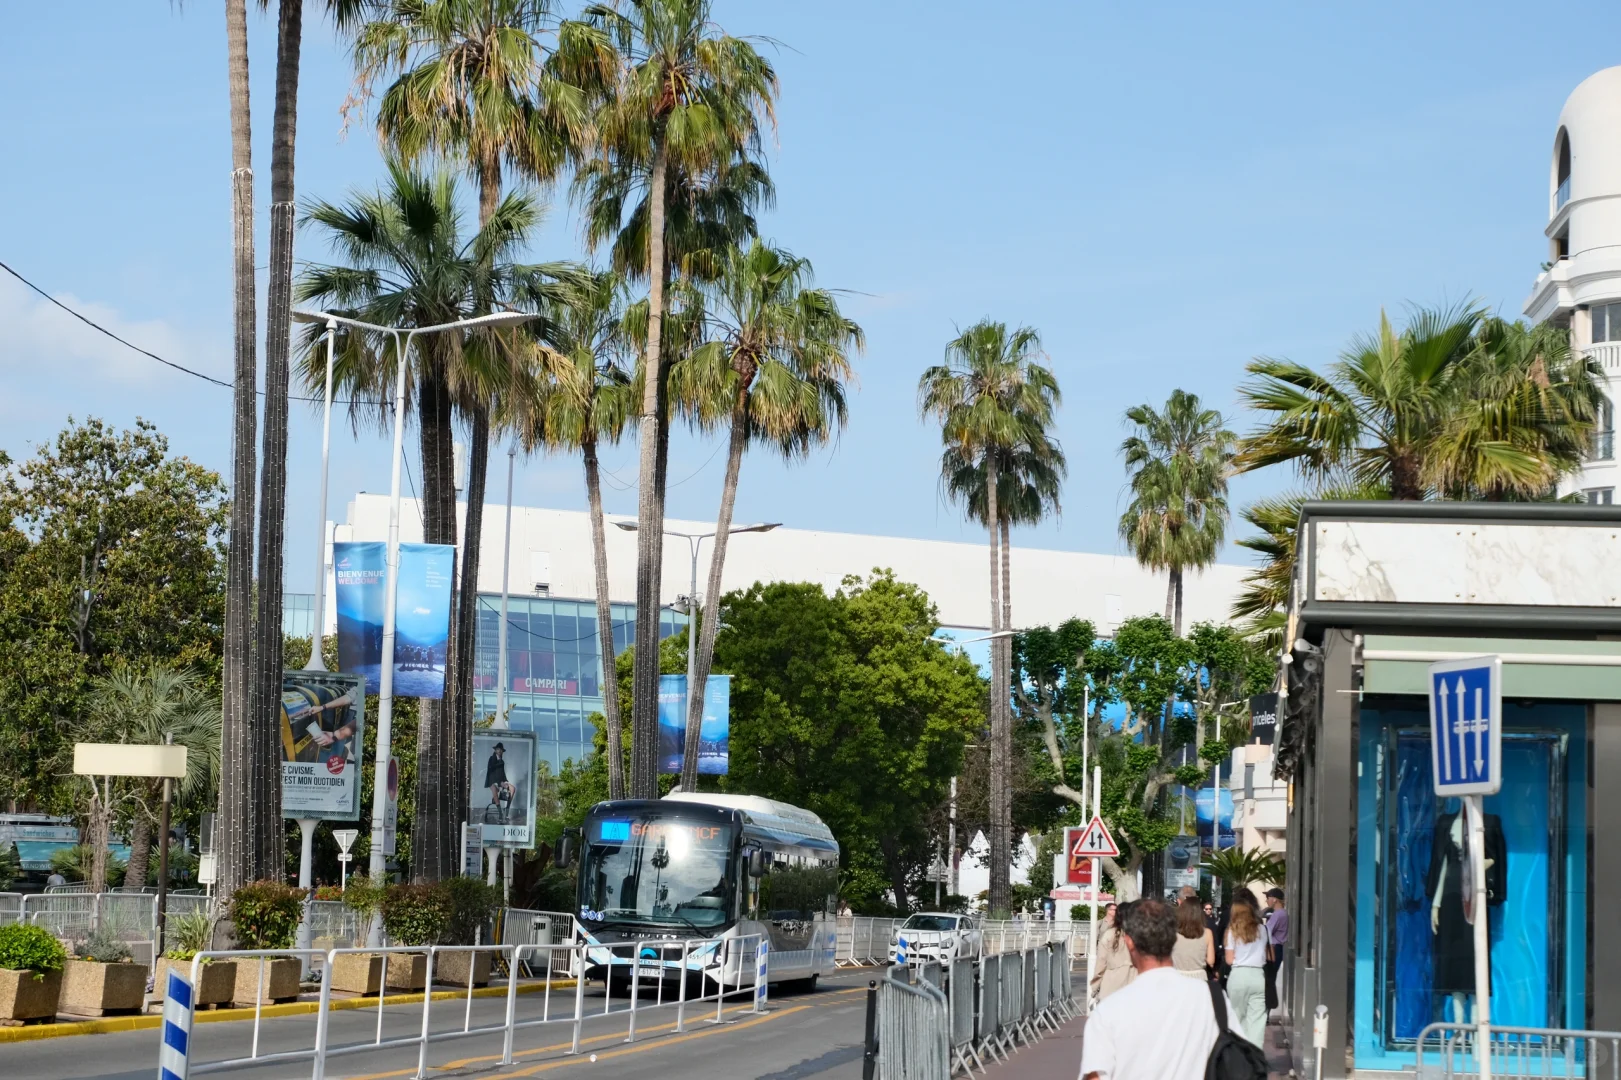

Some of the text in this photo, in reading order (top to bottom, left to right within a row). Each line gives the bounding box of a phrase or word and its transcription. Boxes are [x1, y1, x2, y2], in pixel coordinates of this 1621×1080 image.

[338, 570, 384, 578] BIENVENUE
[338, 577, 378, 585] WELCOME
[525, 677, 567, 689] CAMPARI
[1252, 710, 1276, 728] priceles
[282, 775, 346, 787] 'EST MON QUOTIDIEN
[502, 828, 526, 837] DIOR
